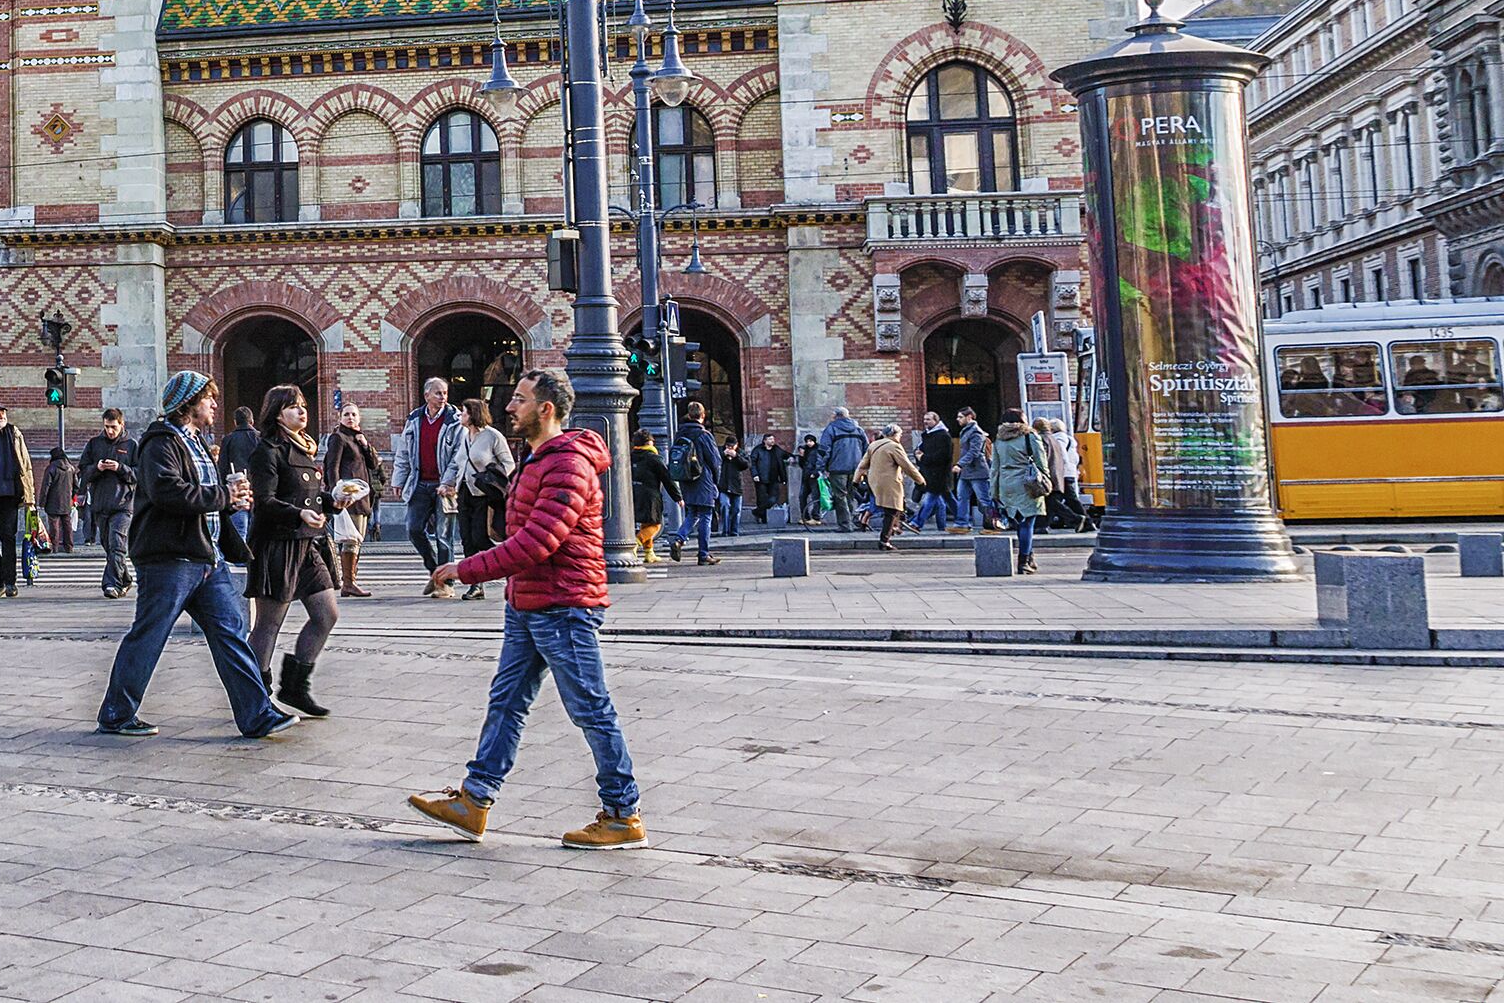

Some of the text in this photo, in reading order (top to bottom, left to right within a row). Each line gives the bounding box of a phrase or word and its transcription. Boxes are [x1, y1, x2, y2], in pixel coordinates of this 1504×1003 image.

[1115, 115, 1202, 140] OPERA
[1149, 360, 1230, 373] Selmeczi György
[1149, 373, 1258, 397] Spiritiszták
